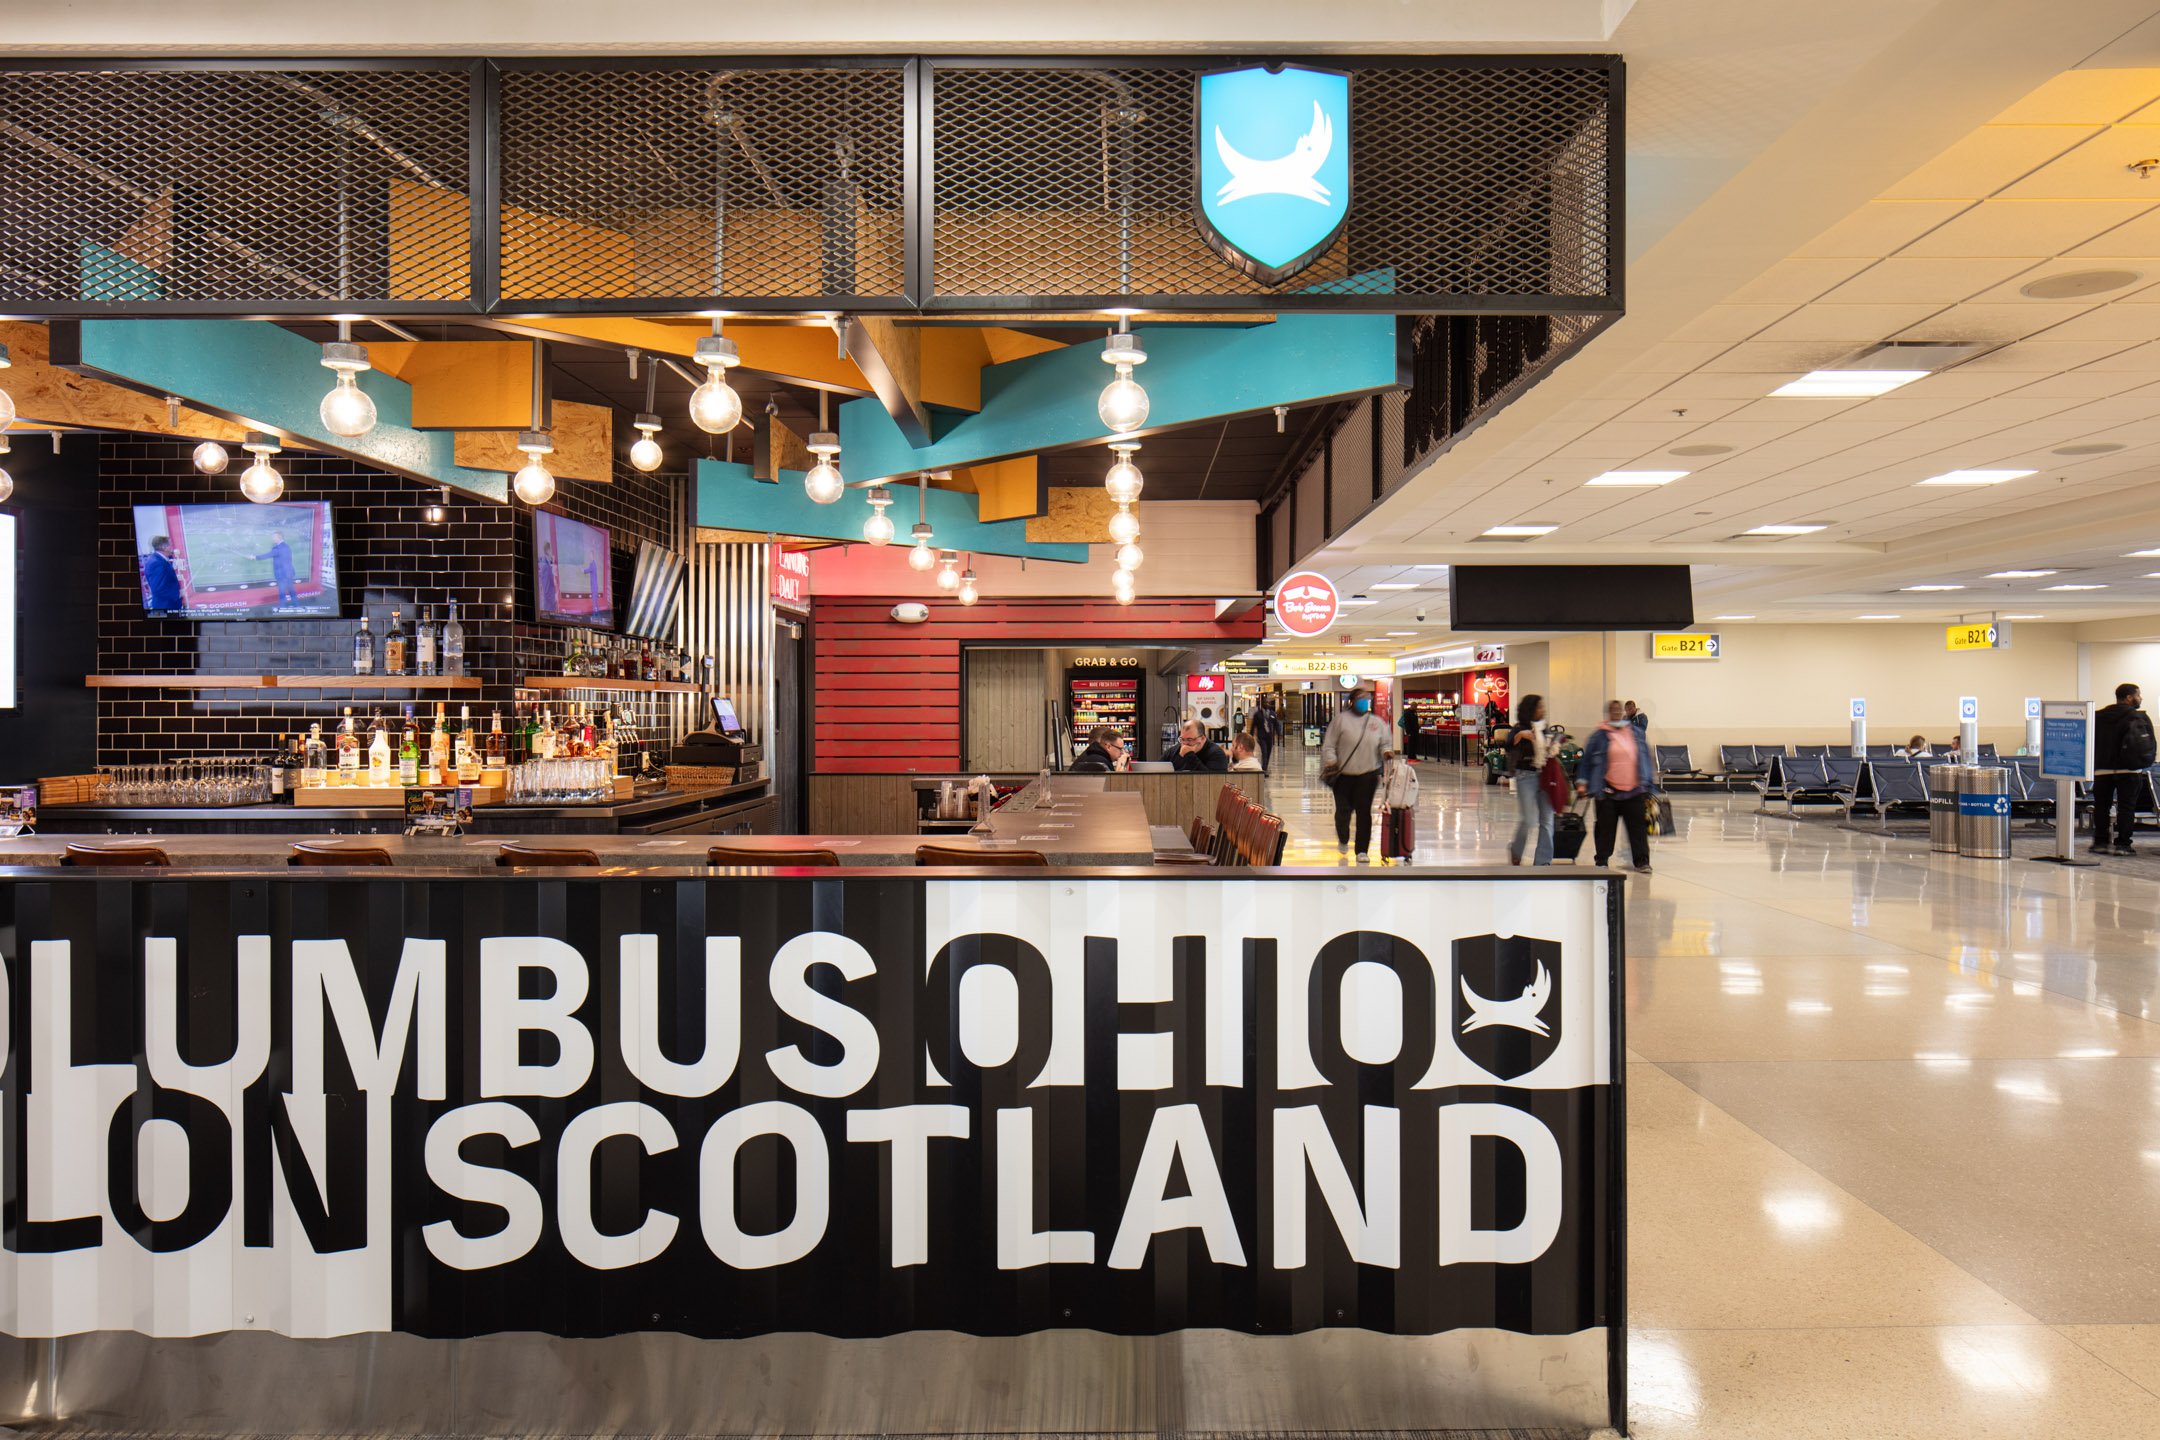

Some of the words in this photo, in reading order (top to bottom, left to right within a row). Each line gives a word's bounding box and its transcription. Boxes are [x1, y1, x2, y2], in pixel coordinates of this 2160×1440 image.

[779, 574, 799, 601] DAILY
[209, 601, 248, 609] DOORDASH
[1283, 602, 1304, 613] Bob
[1340, 635, 1351, 644] EXIT
[1953, 637, 1967, 645] Gate
[1968, 629, 1986, 643] B21
[1680, 640, 1703, 651] B21
[1075, 657, 1107, 667] GRAB
[1109, 657, 1117, 667] &
[1120, 657, 1138, 667] GO
[1308, 662, 1348, 671] B22-B36
[0, 931, 880, 1100] LUMBUS
[926, 930, 1437, 1090] OHIO
[422, 1100, 1563, 1270] SCOTLAND
